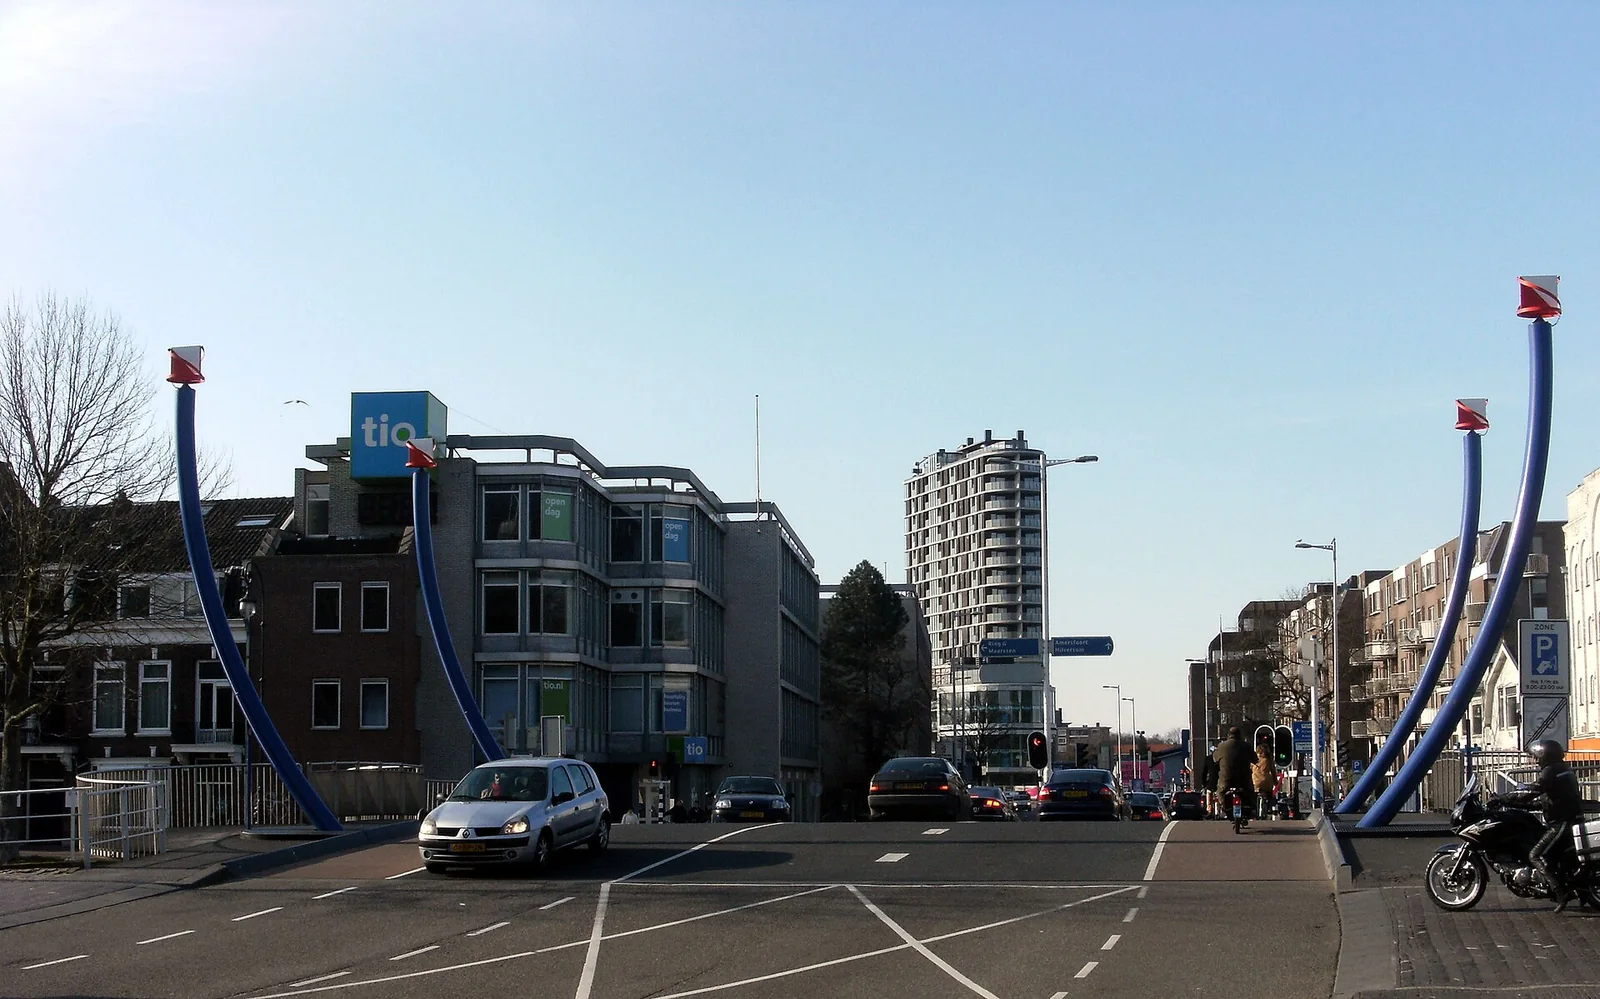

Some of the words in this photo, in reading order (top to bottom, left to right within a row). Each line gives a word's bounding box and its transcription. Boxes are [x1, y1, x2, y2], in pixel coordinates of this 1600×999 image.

[361, 413, 416, 447] tio
[545, 499, 566, 507] open
[545, 506, 561, 518] dag
[665, 523, 683, 531] open
[664, 530, 679, 541] dag
[1537, 636, 1553, 658] P
[543, 681, 564, 689] tio.nl
[686, 743, 703, 755] tio
